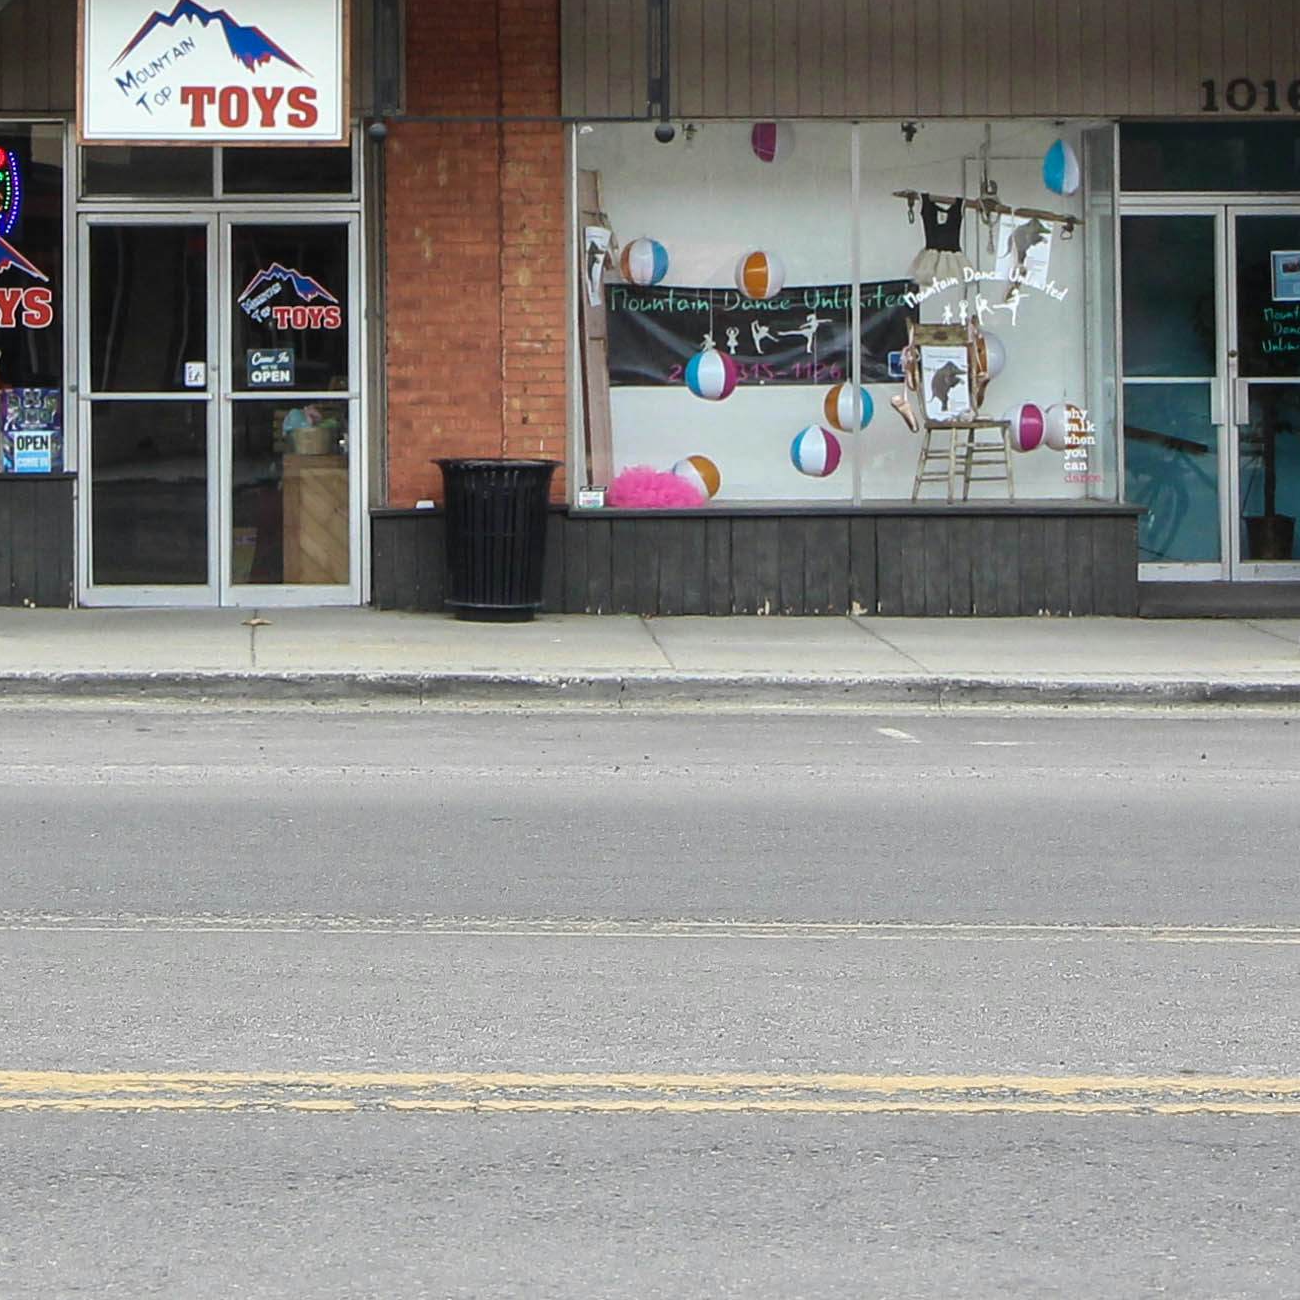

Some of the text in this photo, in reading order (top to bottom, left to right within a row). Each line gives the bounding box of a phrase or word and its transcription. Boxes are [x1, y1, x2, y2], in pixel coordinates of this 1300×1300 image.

[180, 85, 319, 129] TOYS
[611, 288, 710, 313] Mountain
[724, 287, 792, 311] Dance
[273, 306, 342, 330] TOYS
[251, 370, 290, 383] OPEN
[16, 435, 50, 451] OPEN
[1063, 432, 1096, 445] when
[1063, 448, 1088, 460] you
[1063, 461, 1088, 471] can
